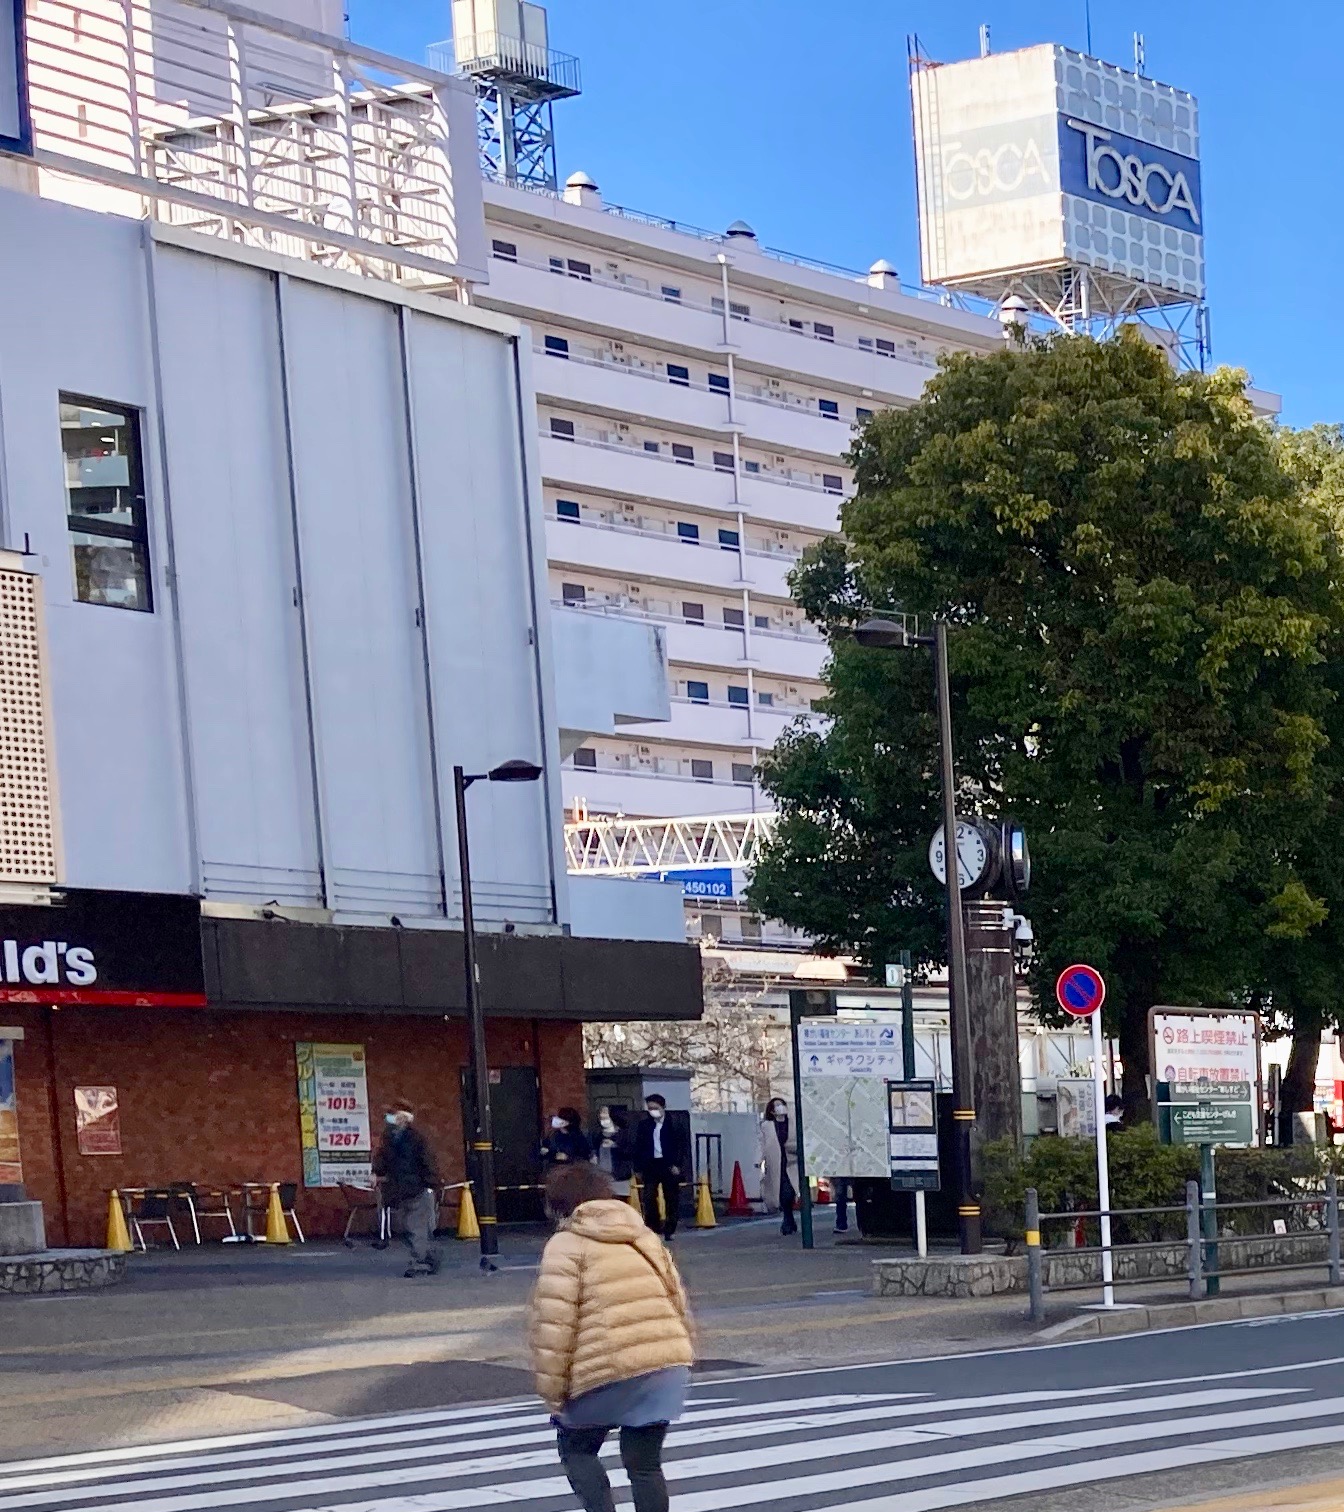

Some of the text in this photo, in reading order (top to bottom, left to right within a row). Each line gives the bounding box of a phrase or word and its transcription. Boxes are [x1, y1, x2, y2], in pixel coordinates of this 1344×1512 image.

[940, 137, 1050, 202] TOSCA
[1067, 118, 1200, 225] TOSCA
[956, 826, 965, 839] 2
[0, 939, 97, 985] ld's
[1176, 1028, 1248, 1046] 路上喫煙禁止
[826, 1055, 894, 1066] ギャラクシティ
